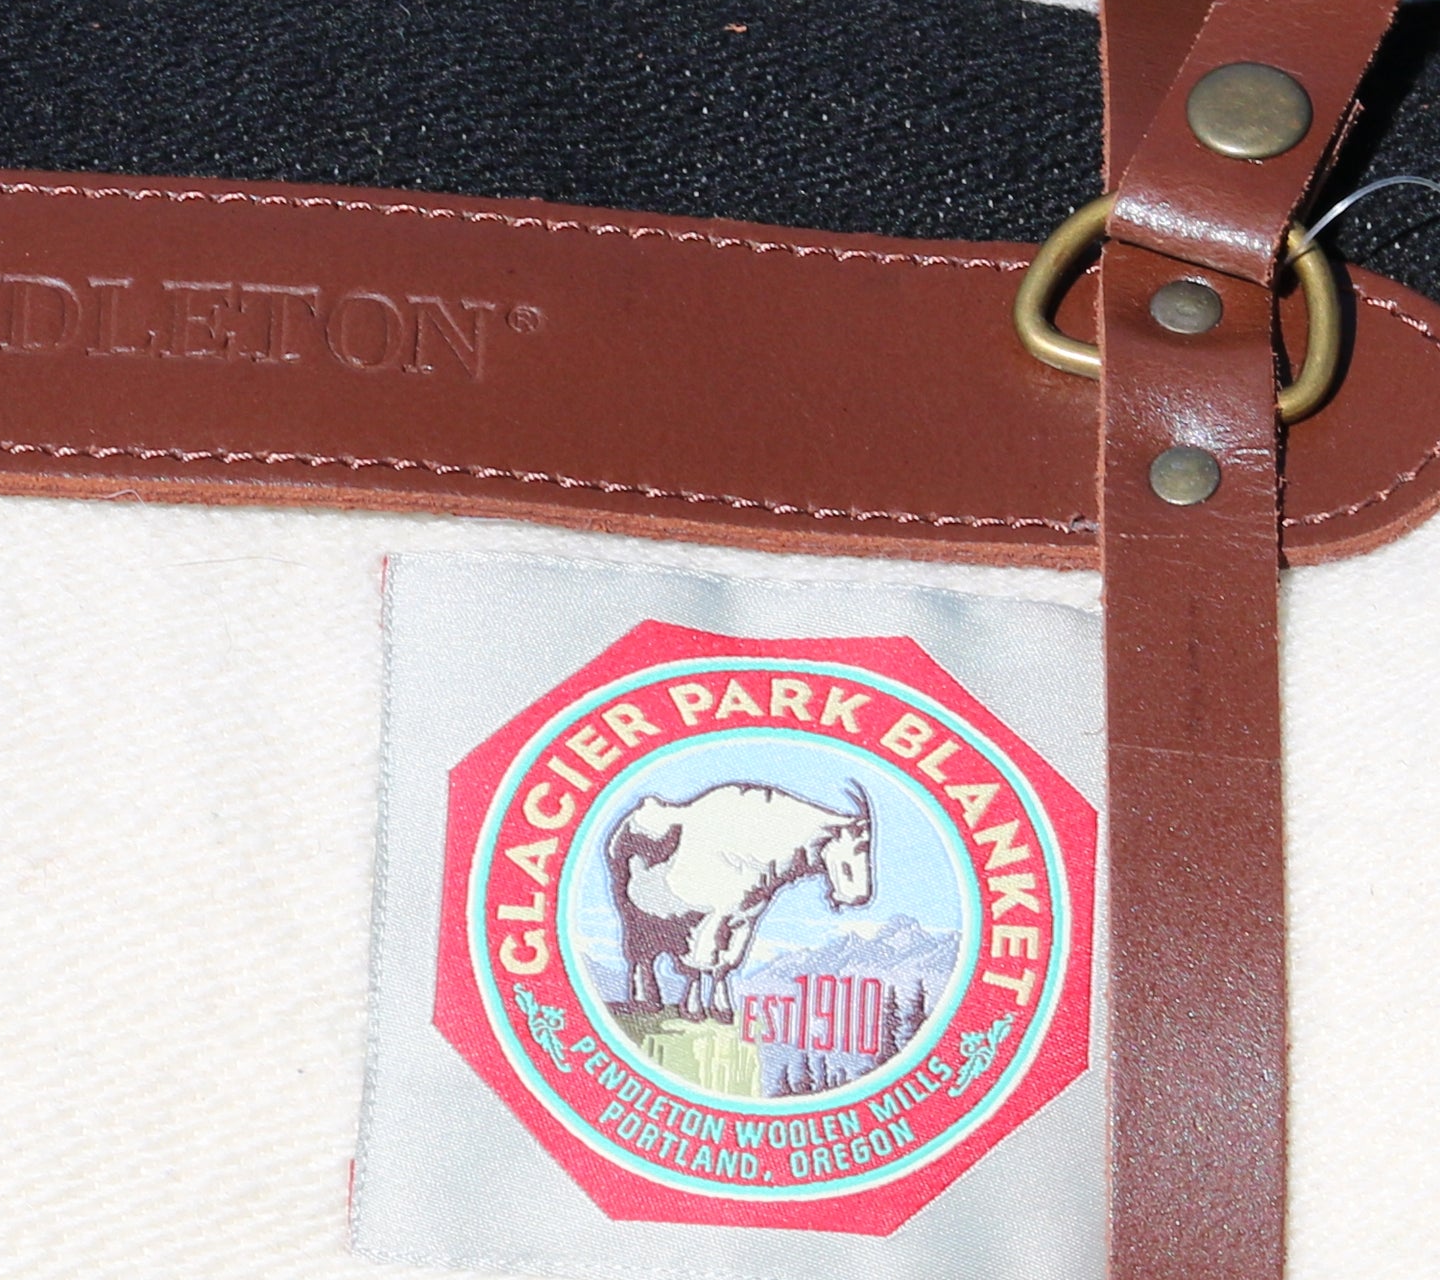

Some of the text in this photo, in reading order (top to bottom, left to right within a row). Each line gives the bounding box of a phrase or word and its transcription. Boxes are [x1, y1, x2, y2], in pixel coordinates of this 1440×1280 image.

[499, 677, 1041, 1007] GLACIER PARK BLANKET
[570, 1037, 955, 1151] PENDLETON WOOLEN MILLS
[602, 1101, 916, 1182] PORTLAND, OREGON
